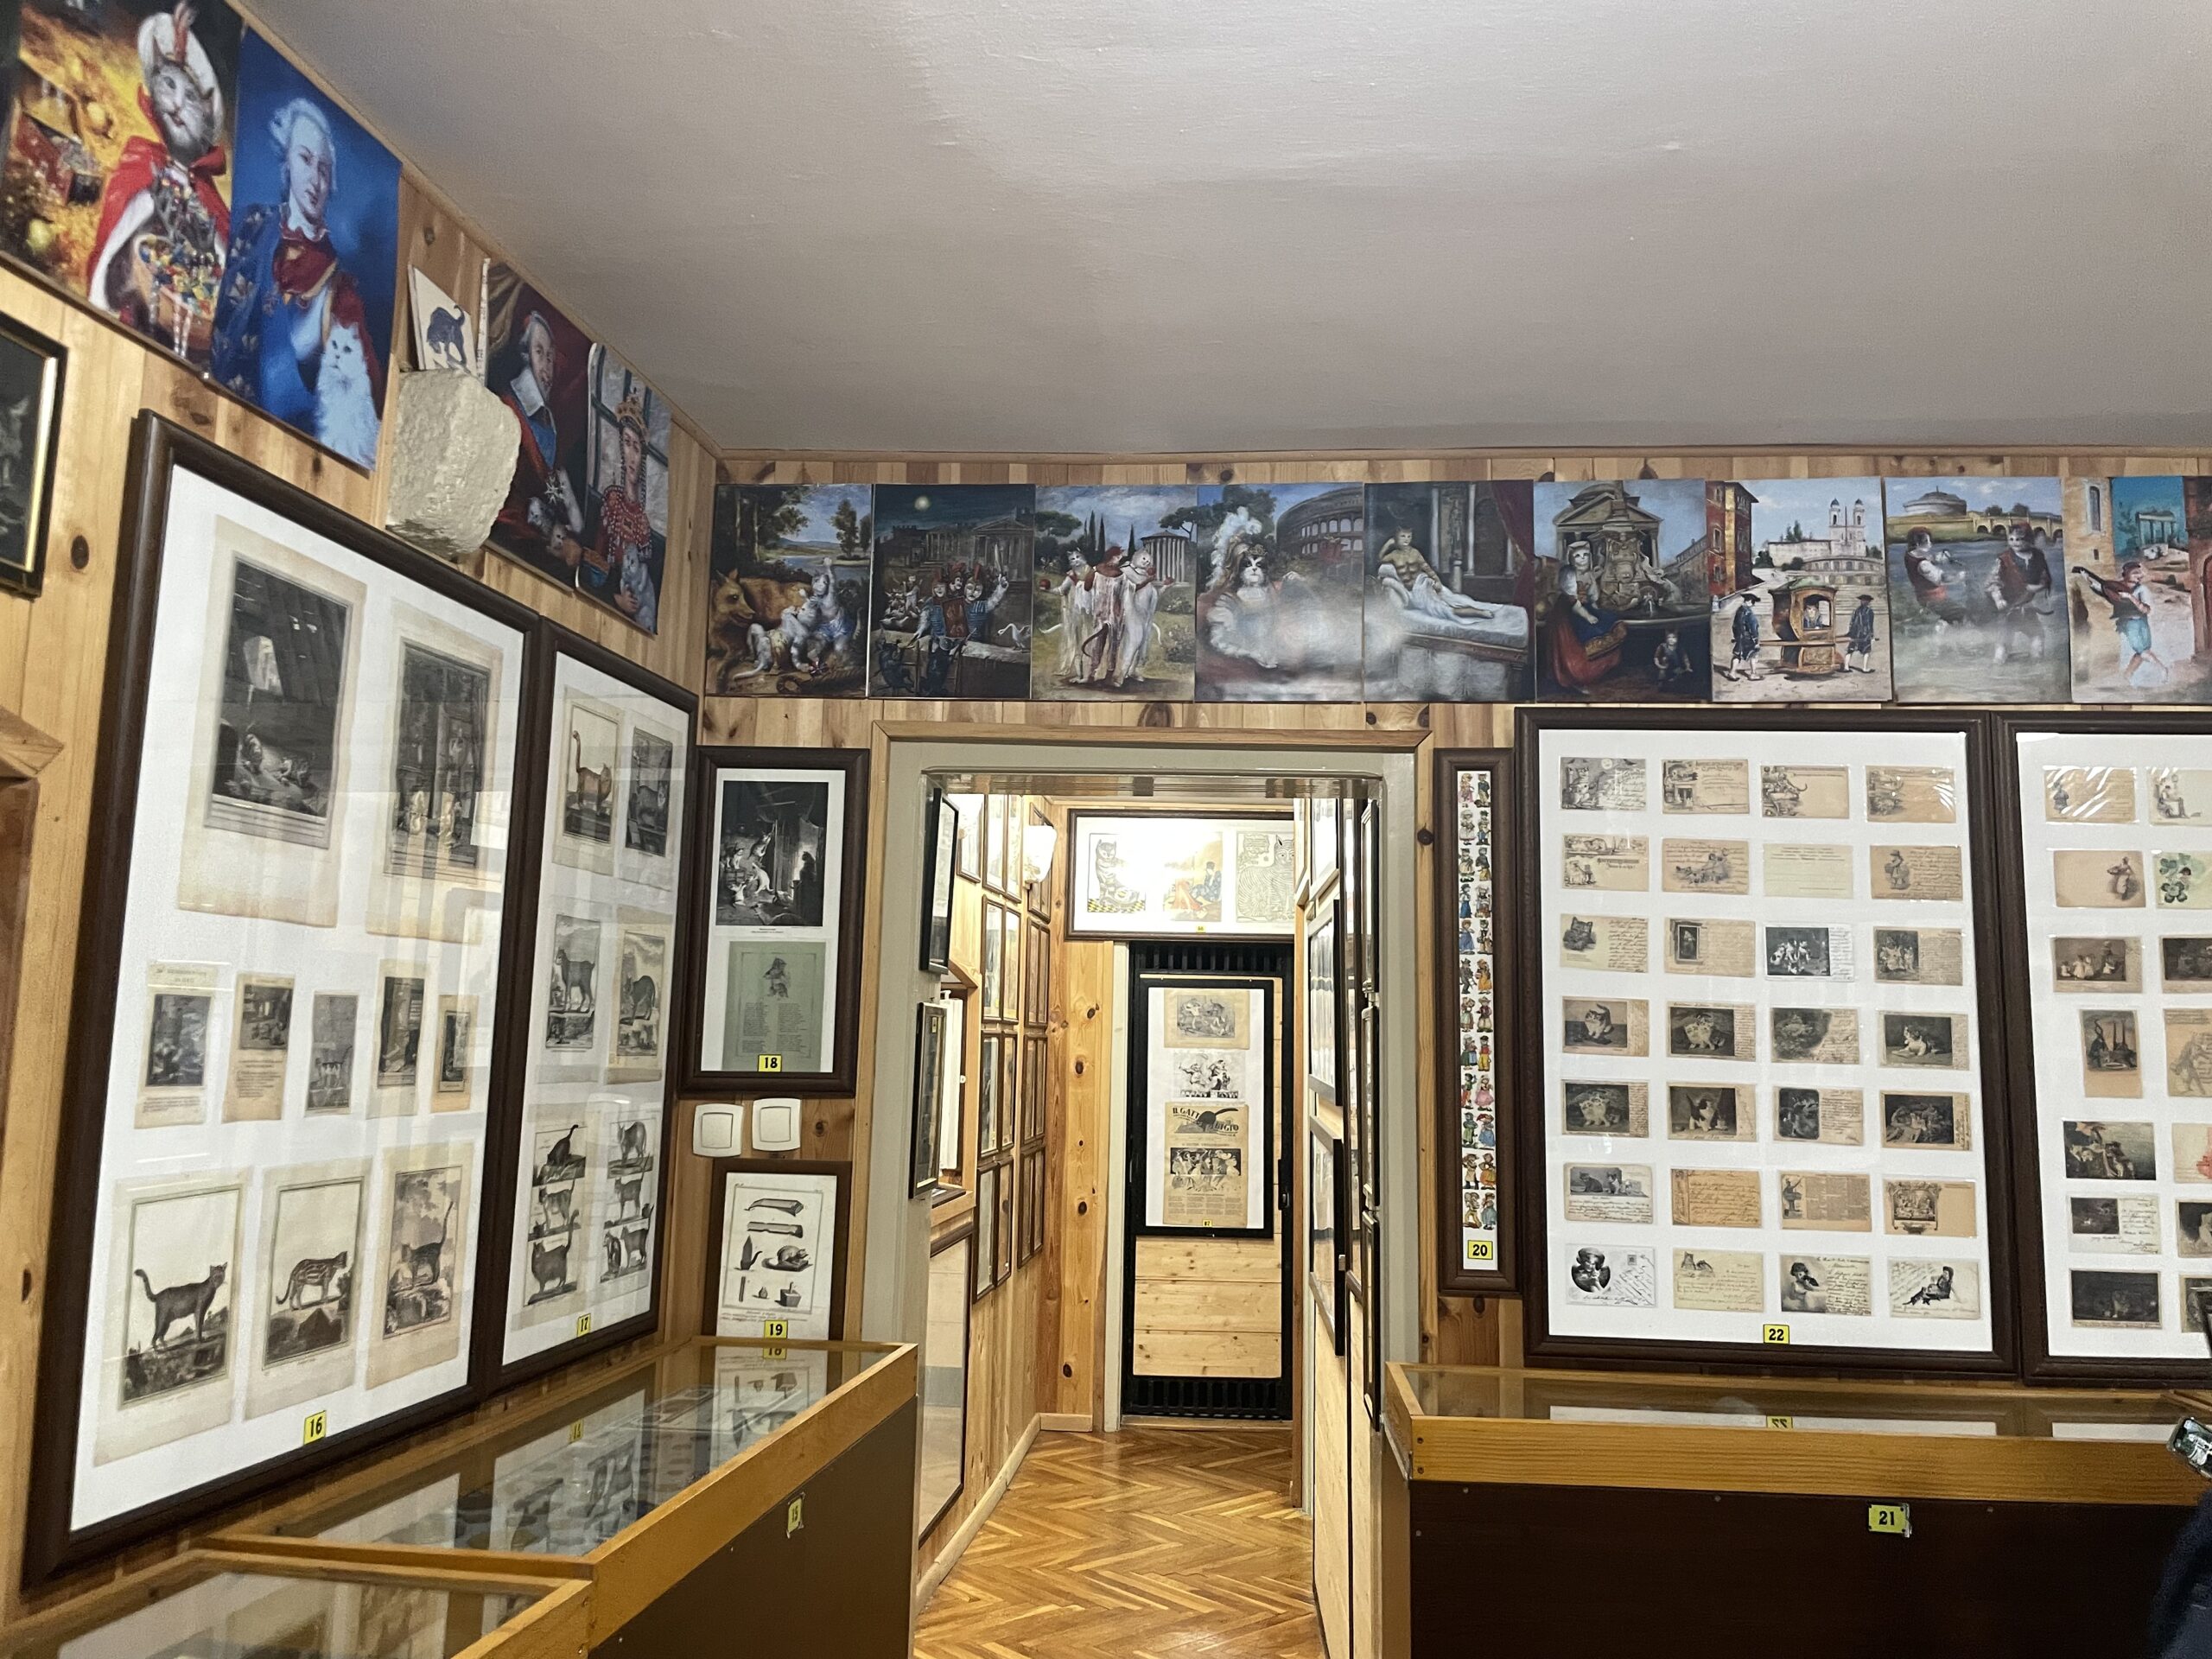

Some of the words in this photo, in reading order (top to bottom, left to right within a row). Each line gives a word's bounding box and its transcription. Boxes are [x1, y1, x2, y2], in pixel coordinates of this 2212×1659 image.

[765, 1057, 778, 1069] 18
[1472, 1243, 1488, 1257] 20
[581, 1316, 588, 1332] 17
[770, 1323, 783, 1336] 19
[1769, 1328, 1784, 1342] 22
[310, 1415, 322, 1438] 16
[1878, 1510, 1895, 1526] 21
